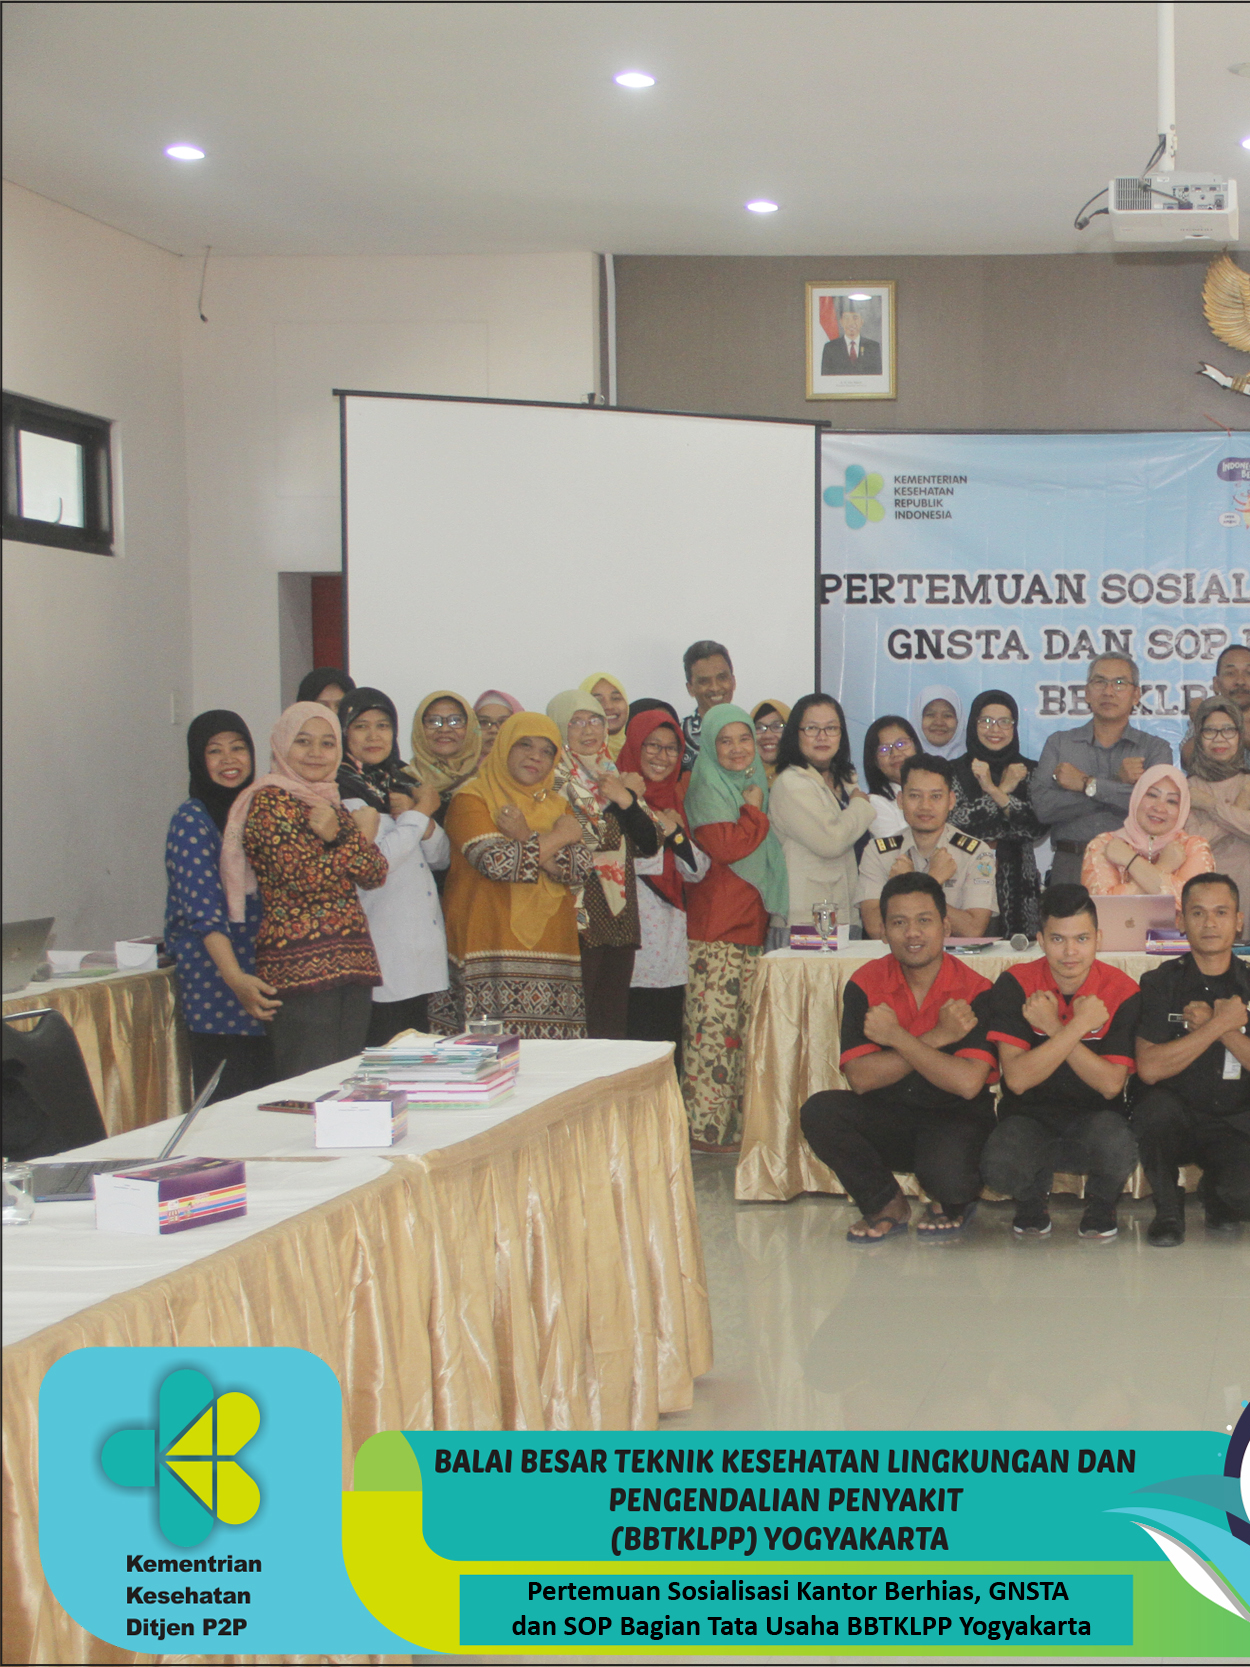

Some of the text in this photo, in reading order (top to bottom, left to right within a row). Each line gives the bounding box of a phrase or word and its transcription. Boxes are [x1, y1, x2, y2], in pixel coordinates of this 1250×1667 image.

[894, 475, 968, 485] KEMENTERIAN
[894, 486, 954, 496] KESEHATAN
[894, 498, 944, 508] REPUBLIK
[894, 510, 953, 520] INDONESIA
[820, 573, 1085, 605] PERTEMUAN
[888, 629, 1029, 660] GNSTA
[1044, 629, 1133, 660] DAN
[1147, 628, 1228, 660] SOP
